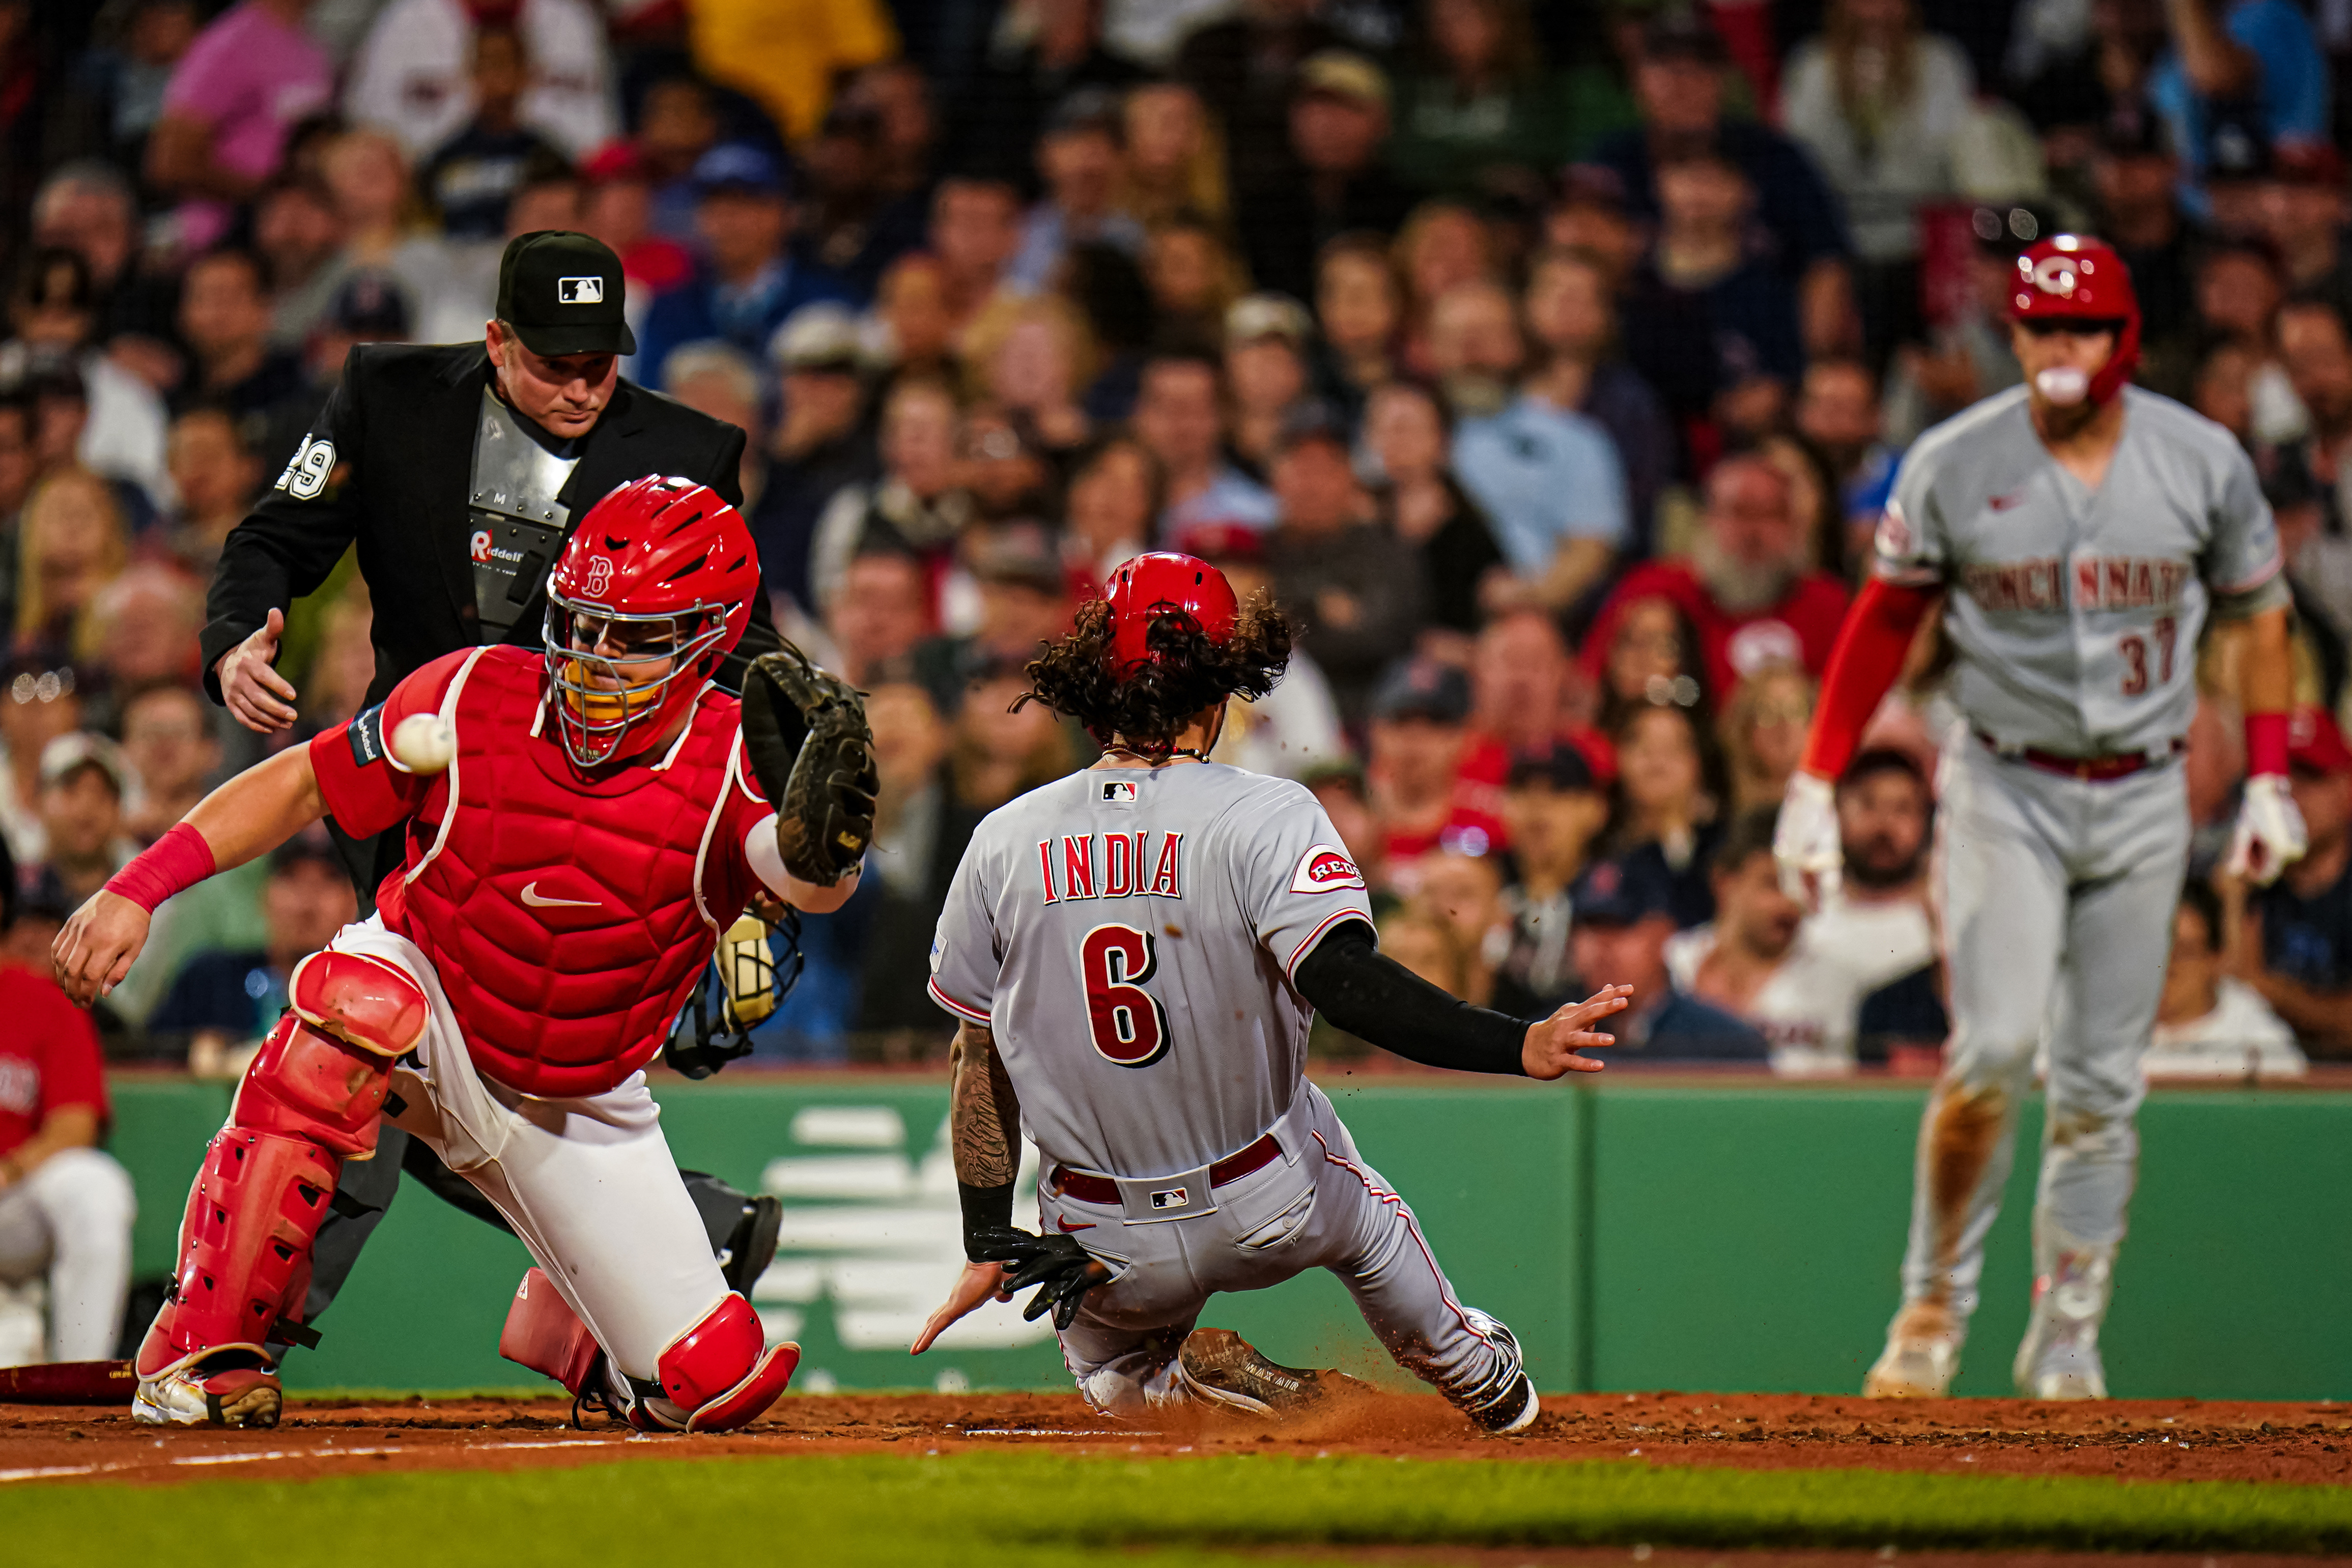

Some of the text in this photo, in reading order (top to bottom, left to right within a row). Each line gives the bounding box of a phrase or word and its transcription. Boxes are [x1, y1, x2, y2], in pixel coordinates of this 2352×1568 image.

[274, 433, 336, 500] 29
[470, 530, 522, 562] Riddell
[581, 555, 614, 598] B
[2120, 617, 2176, 696] 37
[357, 709, 377, 760] ssMutual
[1037, 830, 1183, 905] INDIA
[1311, 861, 1363, 881] REDS
[1079, 922, 1171, 1069] 6
[1243, 1362, 1299, 1391] MAX AIR
